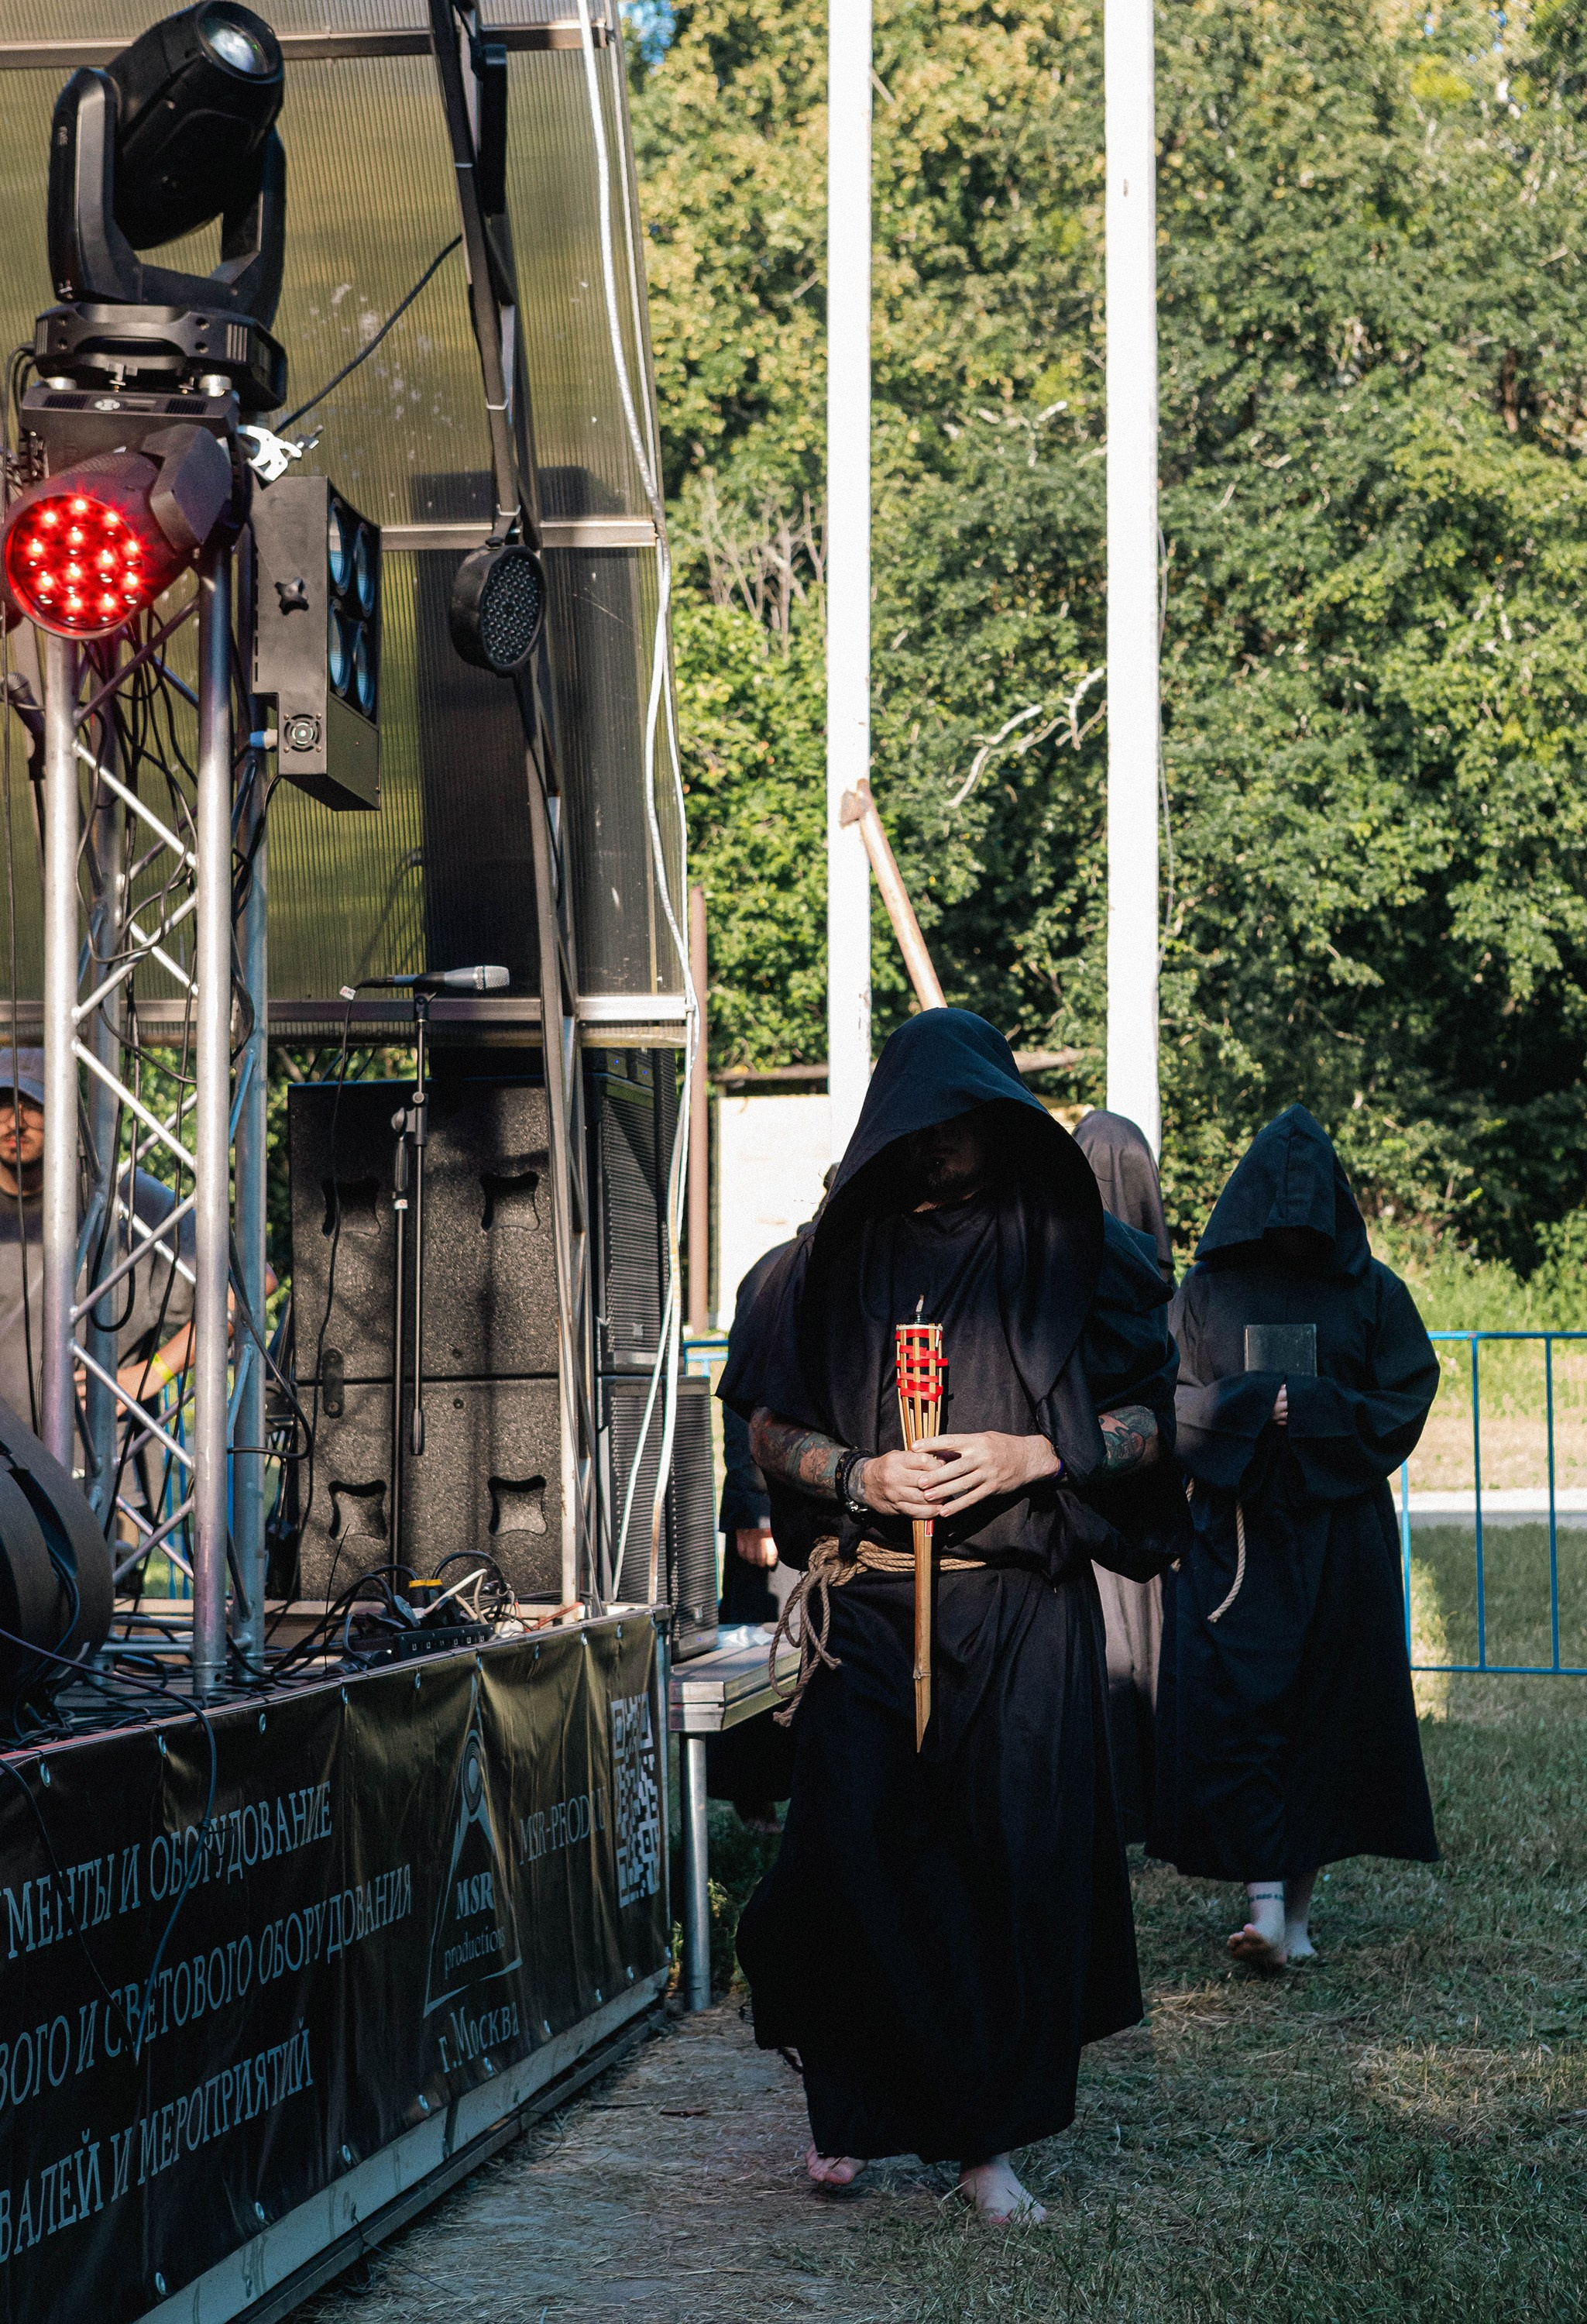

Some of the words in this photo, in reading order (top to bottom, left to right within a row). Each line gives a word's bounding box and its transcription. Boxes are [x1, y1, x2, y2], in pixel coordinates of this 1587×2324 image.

[0, 1854, 115, 1959] МЕНТЫ
[119, 1844, 140, 1913] И
[150, 1781, 332, 1901] ОБОРУДОВАНИЕ
[455, 1872, 495, 1920] MSR
[75, 1999, 98, 2075] И
[105, 1936, 252, 2058] СВЕТОВОГО
[259, 1864, 410, 1985] ОБОРУДОВАНИЯ
[110, 2127, 132, 2202] И
[137, 2016, 313, 2185] МЕРОПРИЯТИЙ
